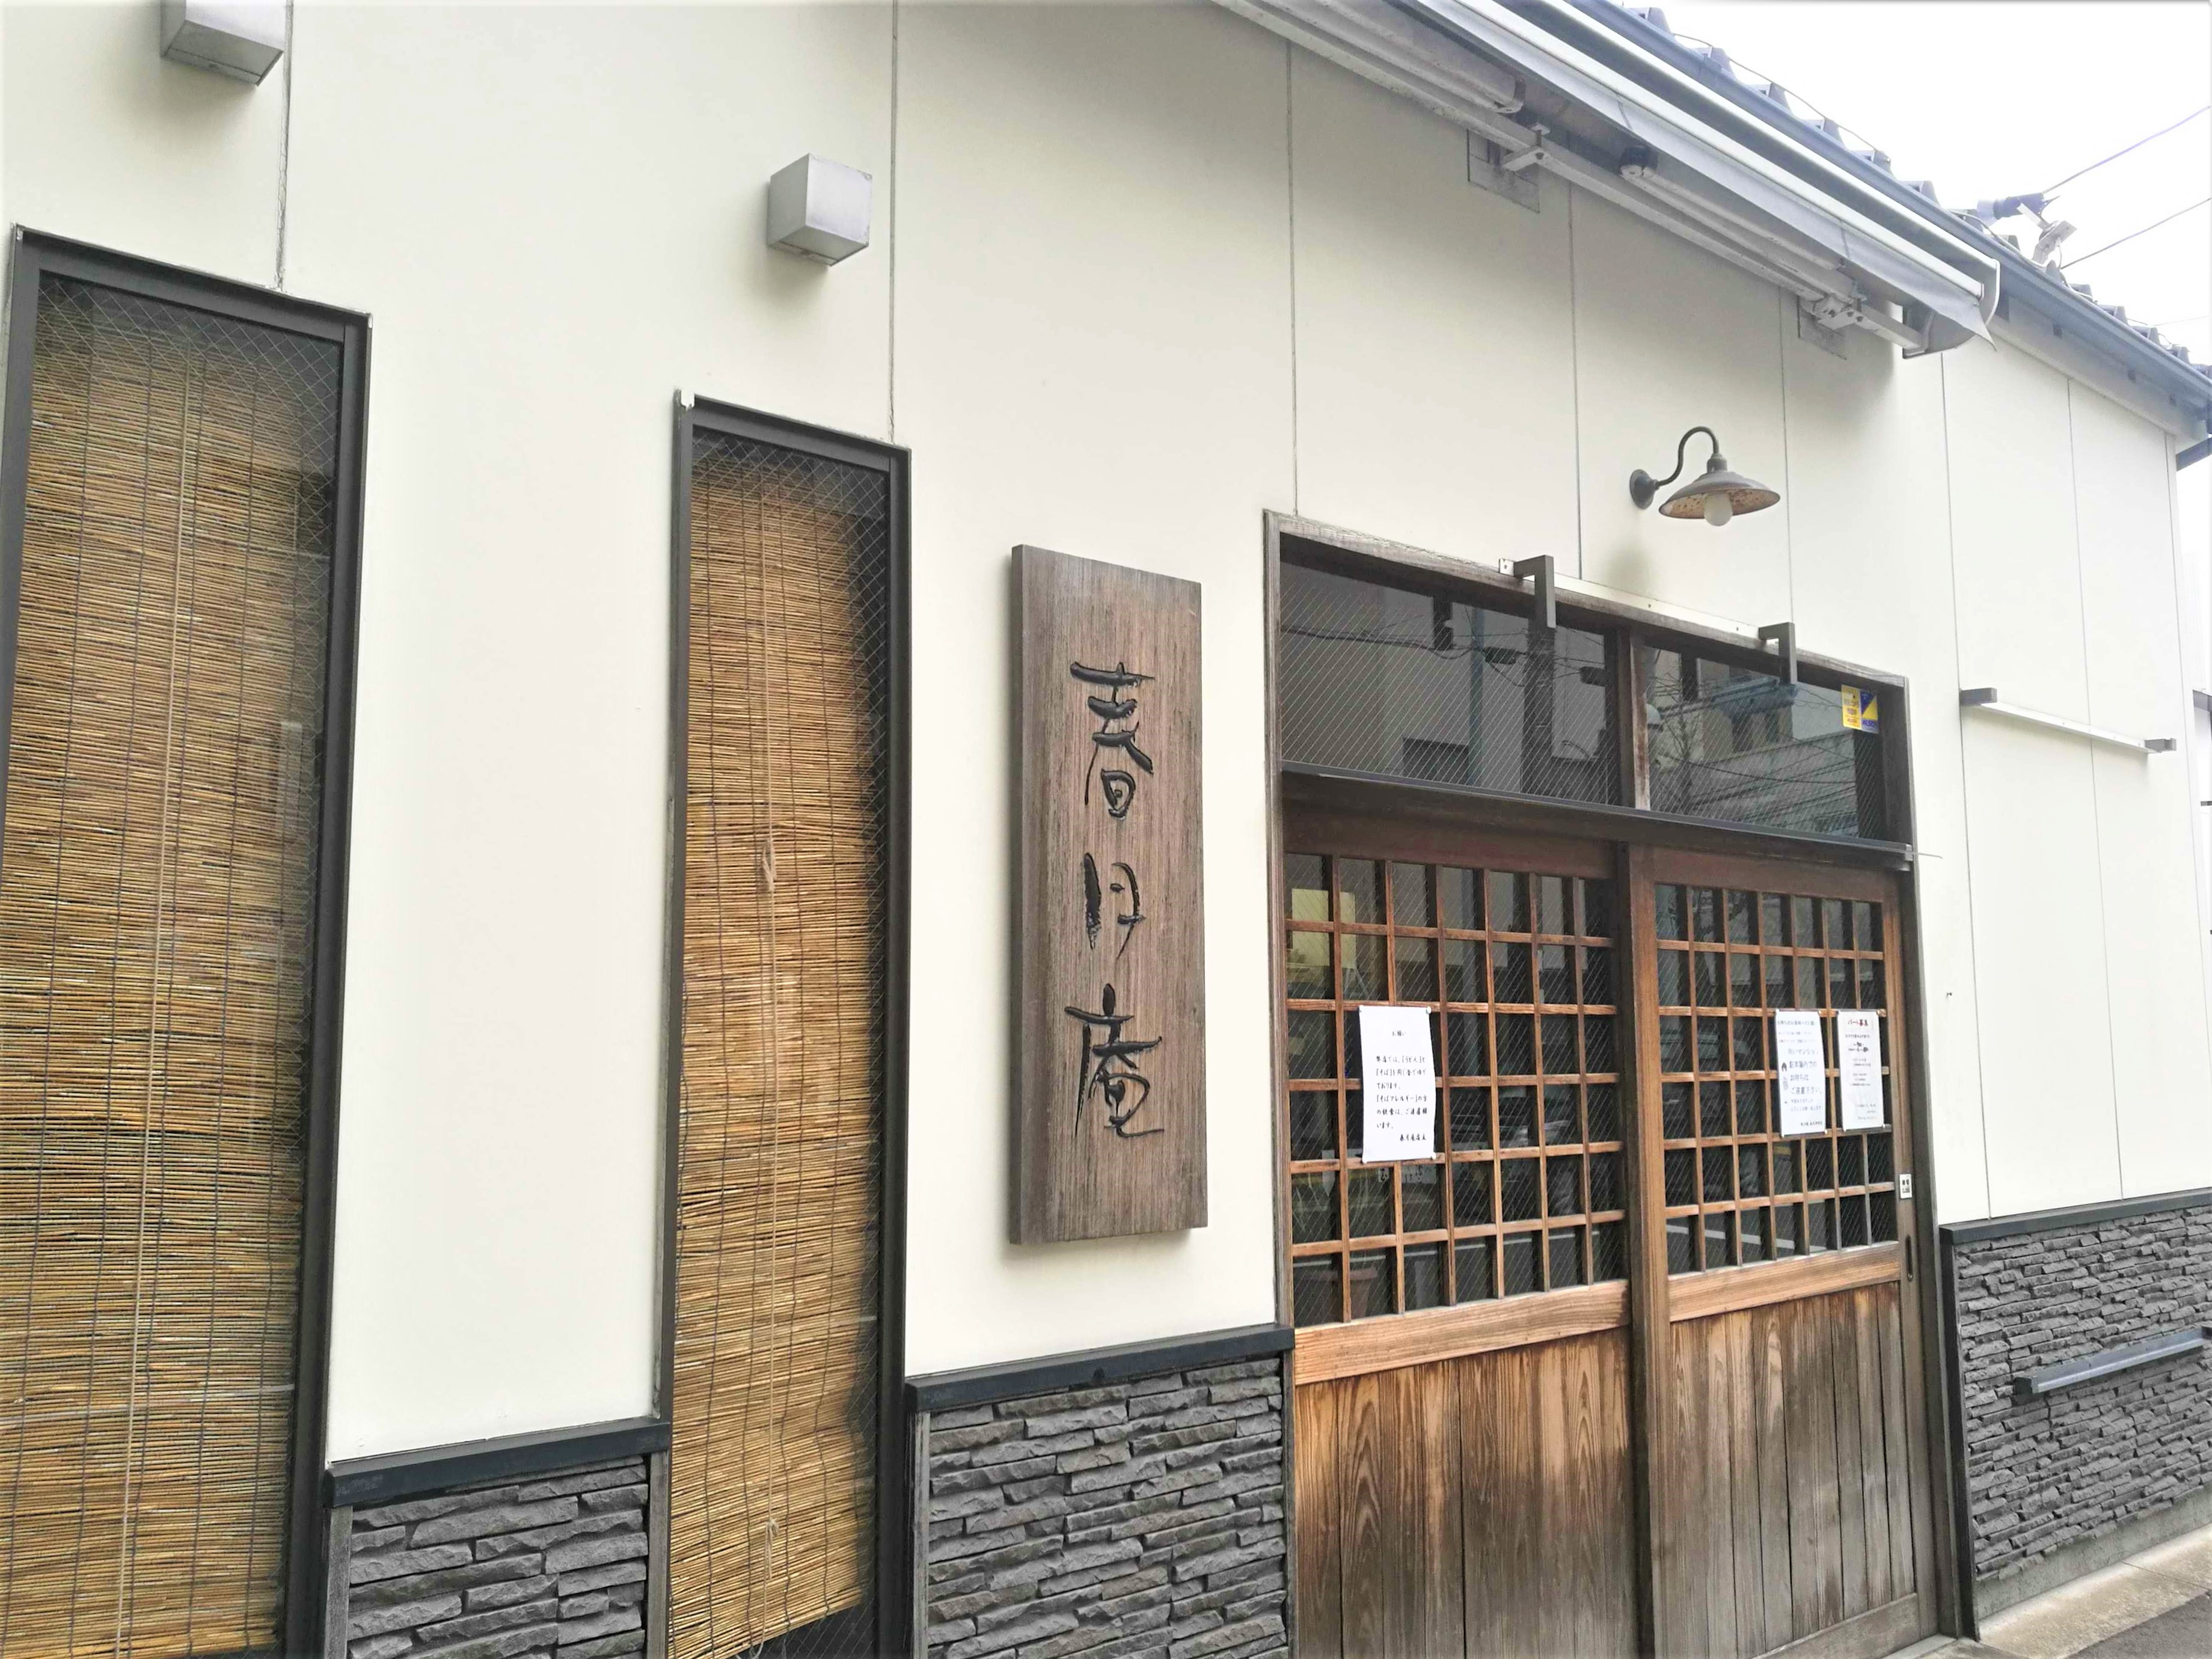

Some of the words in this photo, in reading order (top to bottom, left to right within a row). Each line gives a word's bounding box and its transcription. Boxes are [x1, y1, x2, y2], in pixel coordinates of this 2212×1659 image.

[1376, 1094, 1427, 1102] 「そばアレルギー」の方
[1376, 1121, 1394, 1129] います。
